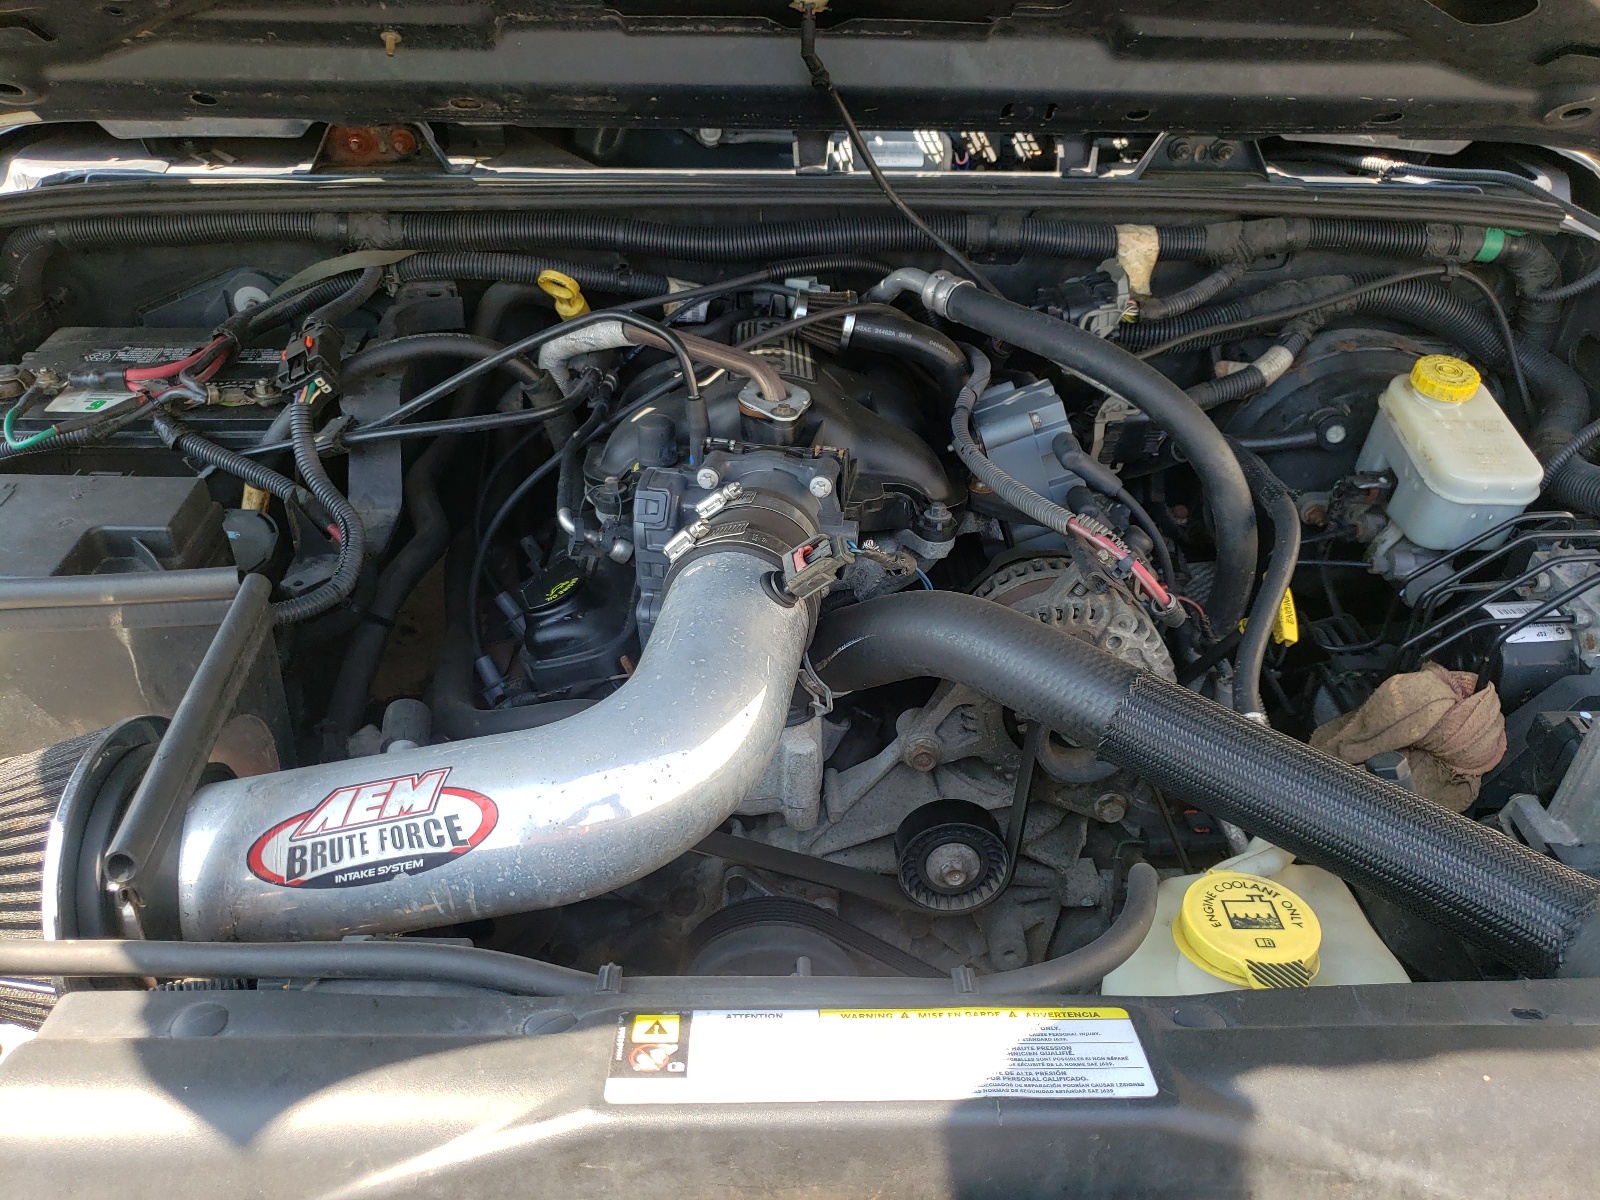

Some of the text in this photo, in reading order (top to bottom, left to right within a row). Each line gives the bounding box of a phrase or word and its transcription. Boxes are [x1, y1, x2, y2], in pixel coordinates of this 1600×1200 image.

[290, 767, 452, 841] AEM
[285, 814, 470, 884] BRUTE FORCE
[335, 859, 424, 883] INTAKE SYSTEM
[1203, 880, 1303, 928] ENGINE COOLANT ONLY
